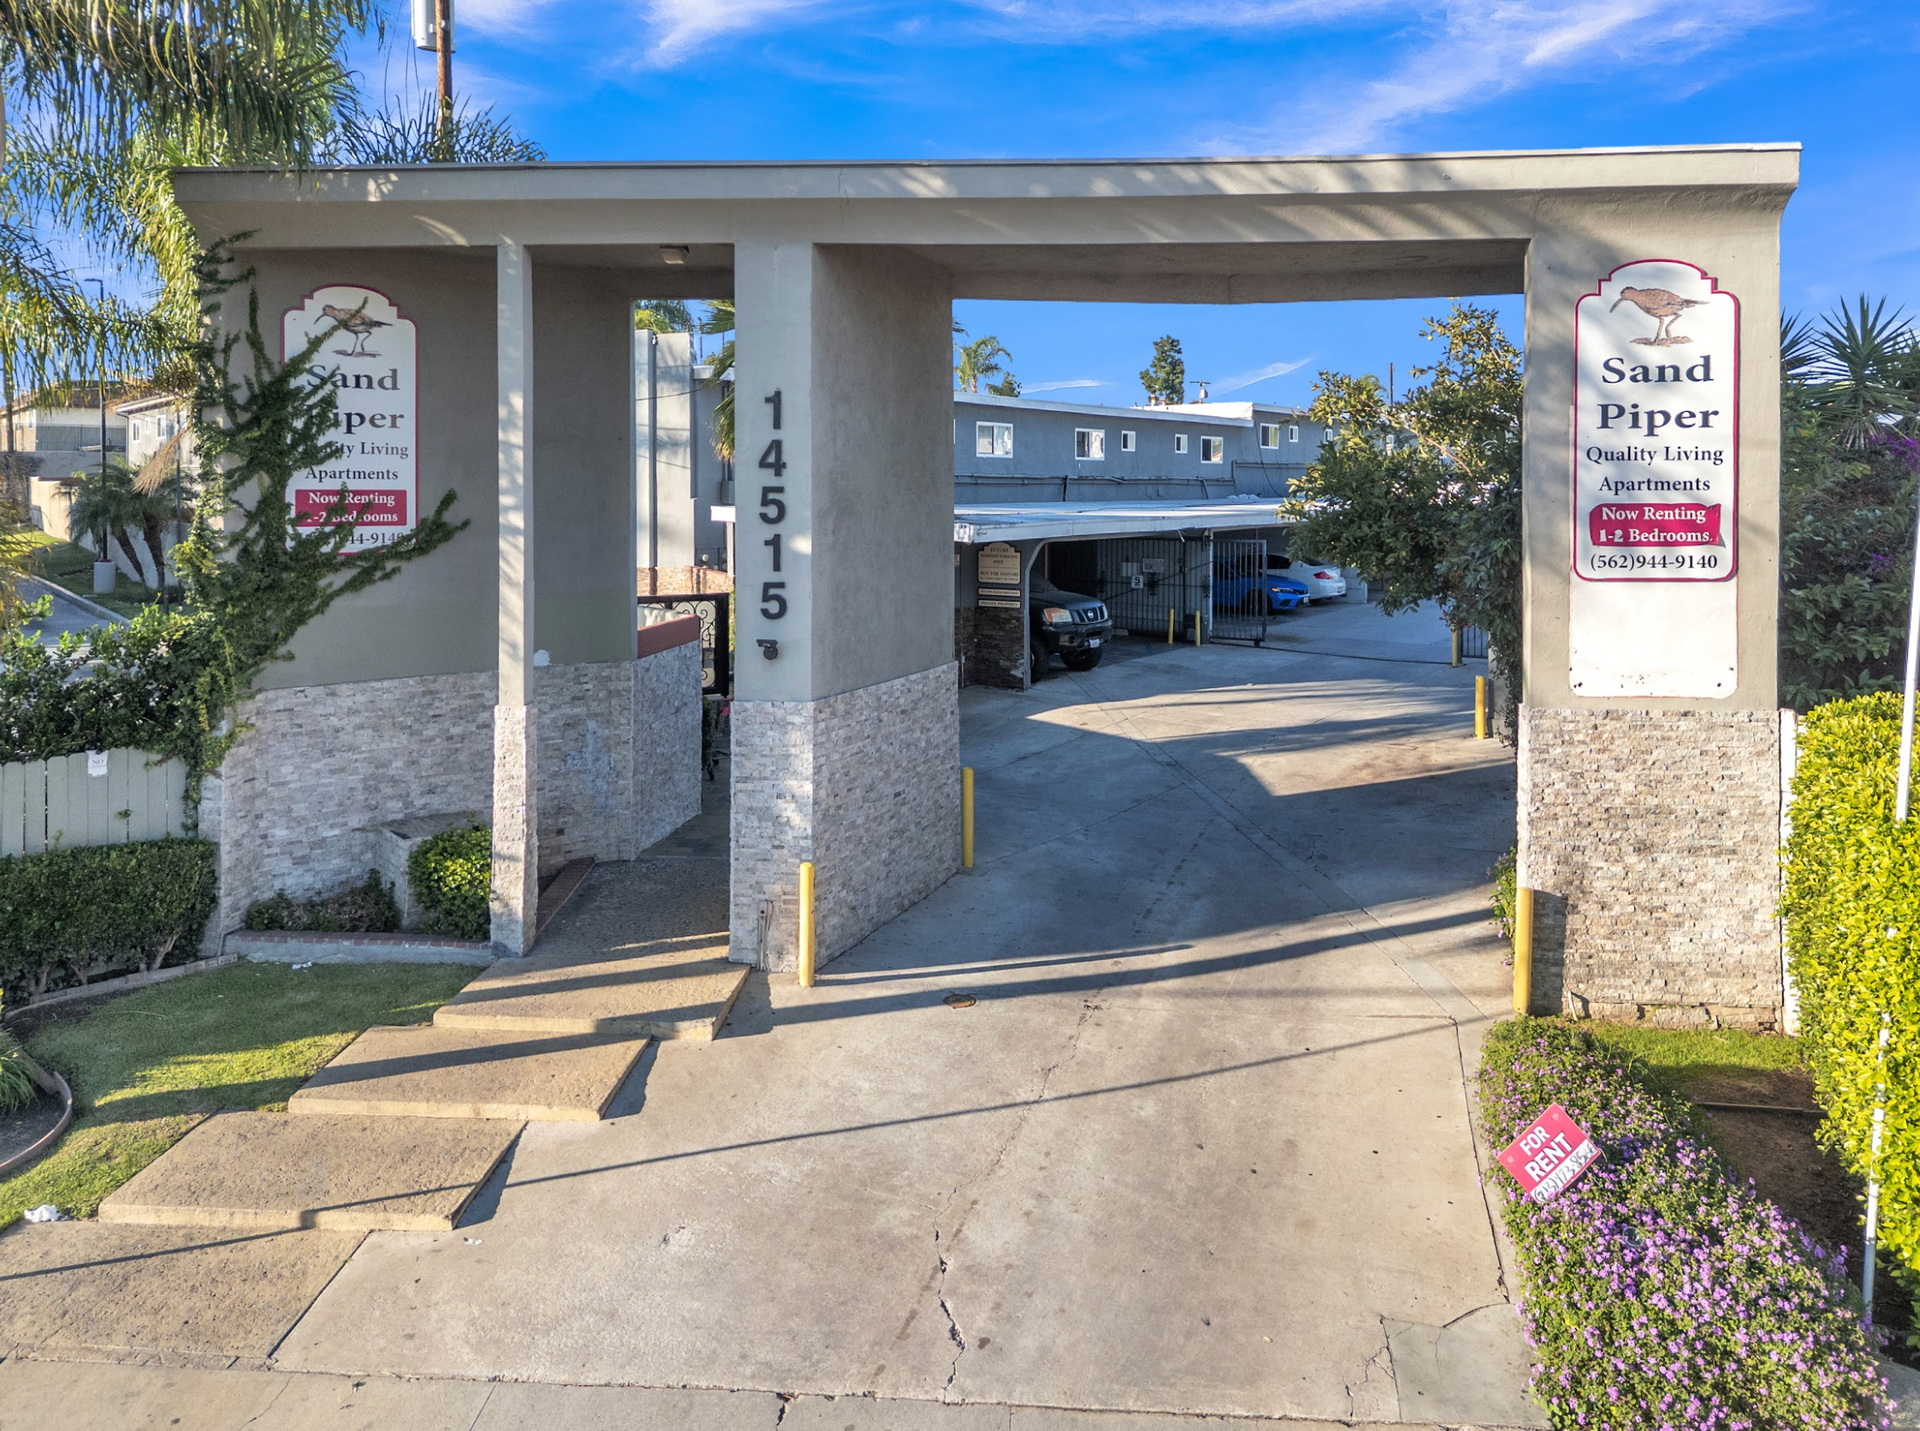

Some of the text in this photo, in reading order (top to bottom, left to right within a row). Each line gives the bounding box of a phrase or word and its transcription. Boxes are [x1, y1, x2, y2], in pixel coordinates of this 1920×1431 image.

[306, 364, 401, 391] Sand
[1601, 354, 1714, 383] Sand
[305, 403, 405, 435] iper
[1596, 403, 1720, 437] Piper
[360, 441, 409, 460] Living
[1586, 445, 1724, 466] Quality Living
[304, 466, 399, 483] Apartments
[1598, 476, 1711, 496] Apartments
[308, 491, 396, 507] Now Renting
[758, 390, 788, 621] 14515
[1602, 506, 1707, 524] Now Renting
[1599, 528, 1710, 543] 1-2 Bedrooms
[1590, 553, 1718, 572] (562)944-9140
[1519, 1126, 1551, 1157] FOR
[1524, 1132, 1573, 1183] RENT
